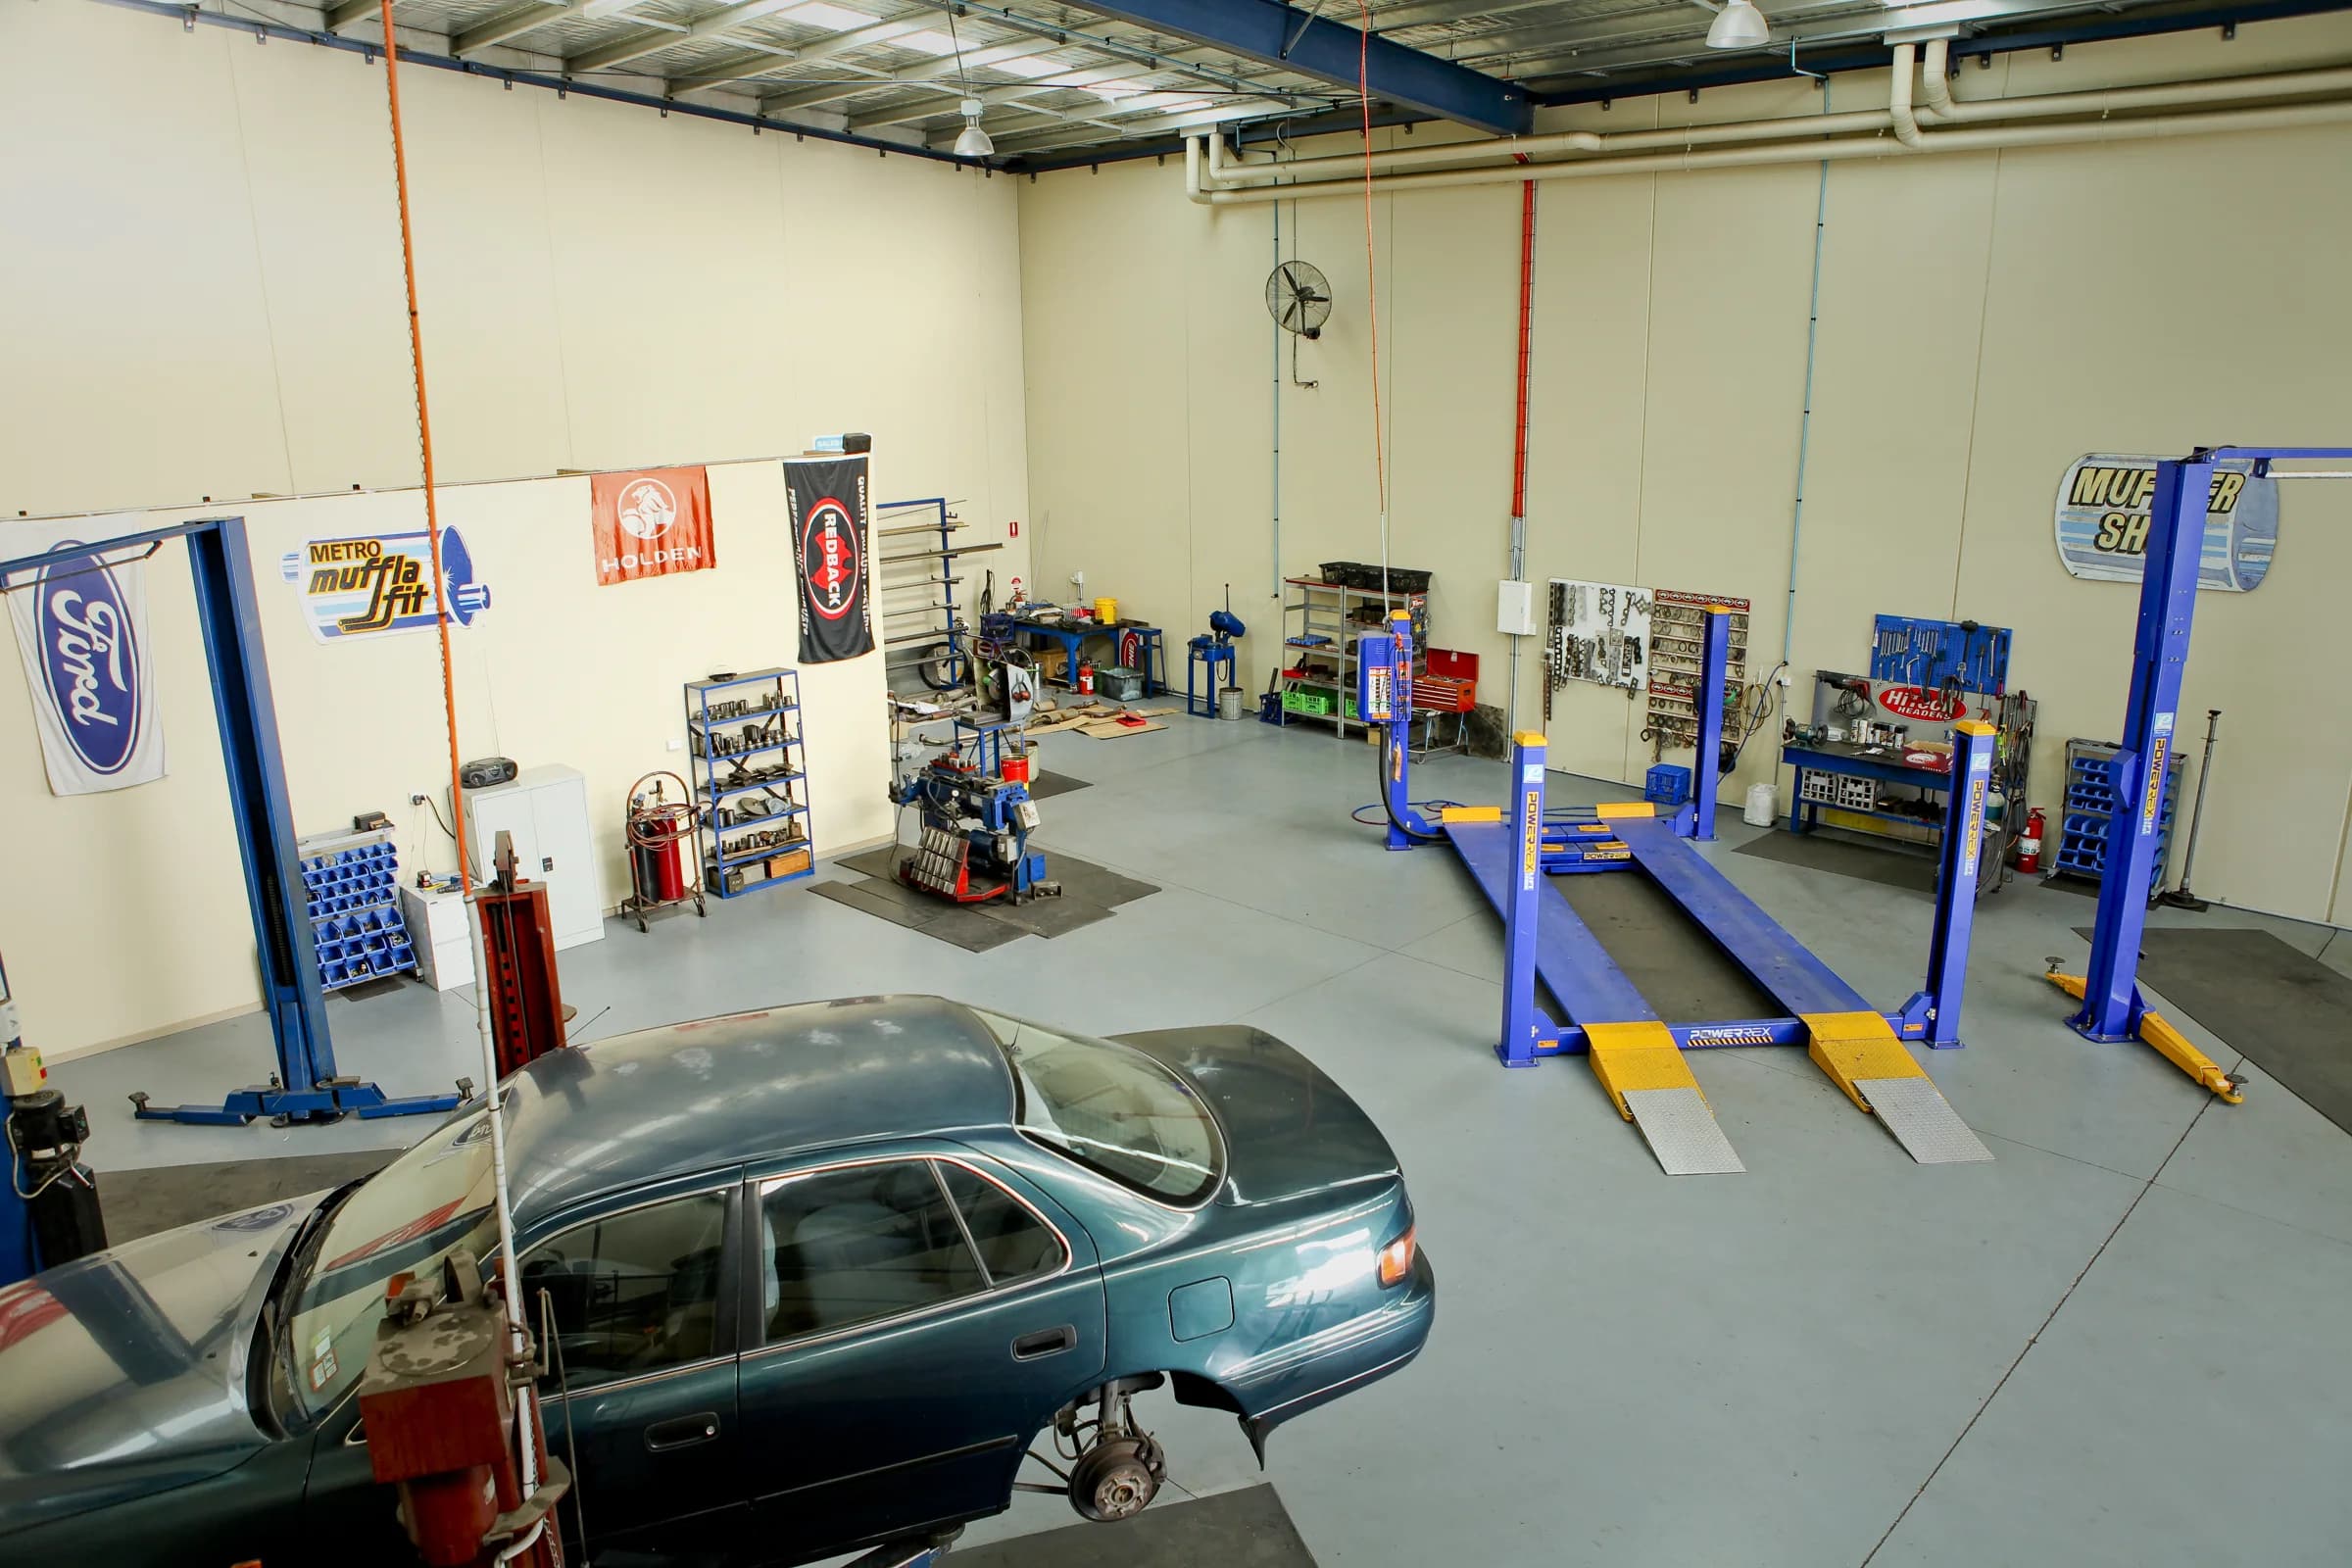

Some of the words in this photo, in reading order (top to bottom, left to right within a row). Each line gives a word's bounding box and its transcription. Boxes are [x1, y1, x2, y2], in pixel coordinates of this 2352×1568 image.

[858, 475, 866, 525] QUALITY
[2068, 466, 2246, 514] MUFER
[310, 541, 381, 563] METRO
[2093, 512, 2152, 555] SH
[602, 546, 703, 573] HOLDEN
[824, 513, 841, 608] REDBACK
[309, 555, 420, 625] muffla
[51, 589, 128, 726] Ford
[1897, 707, 1951, 720] HEADERS
[2145, 740, 2165, 816] POWERREX
[1526, 793, 1538, 871] POWERREX
[1967, 781, 1984, 857] POWERREX
[1690, 1027, 1772, 1040] POWERREX
